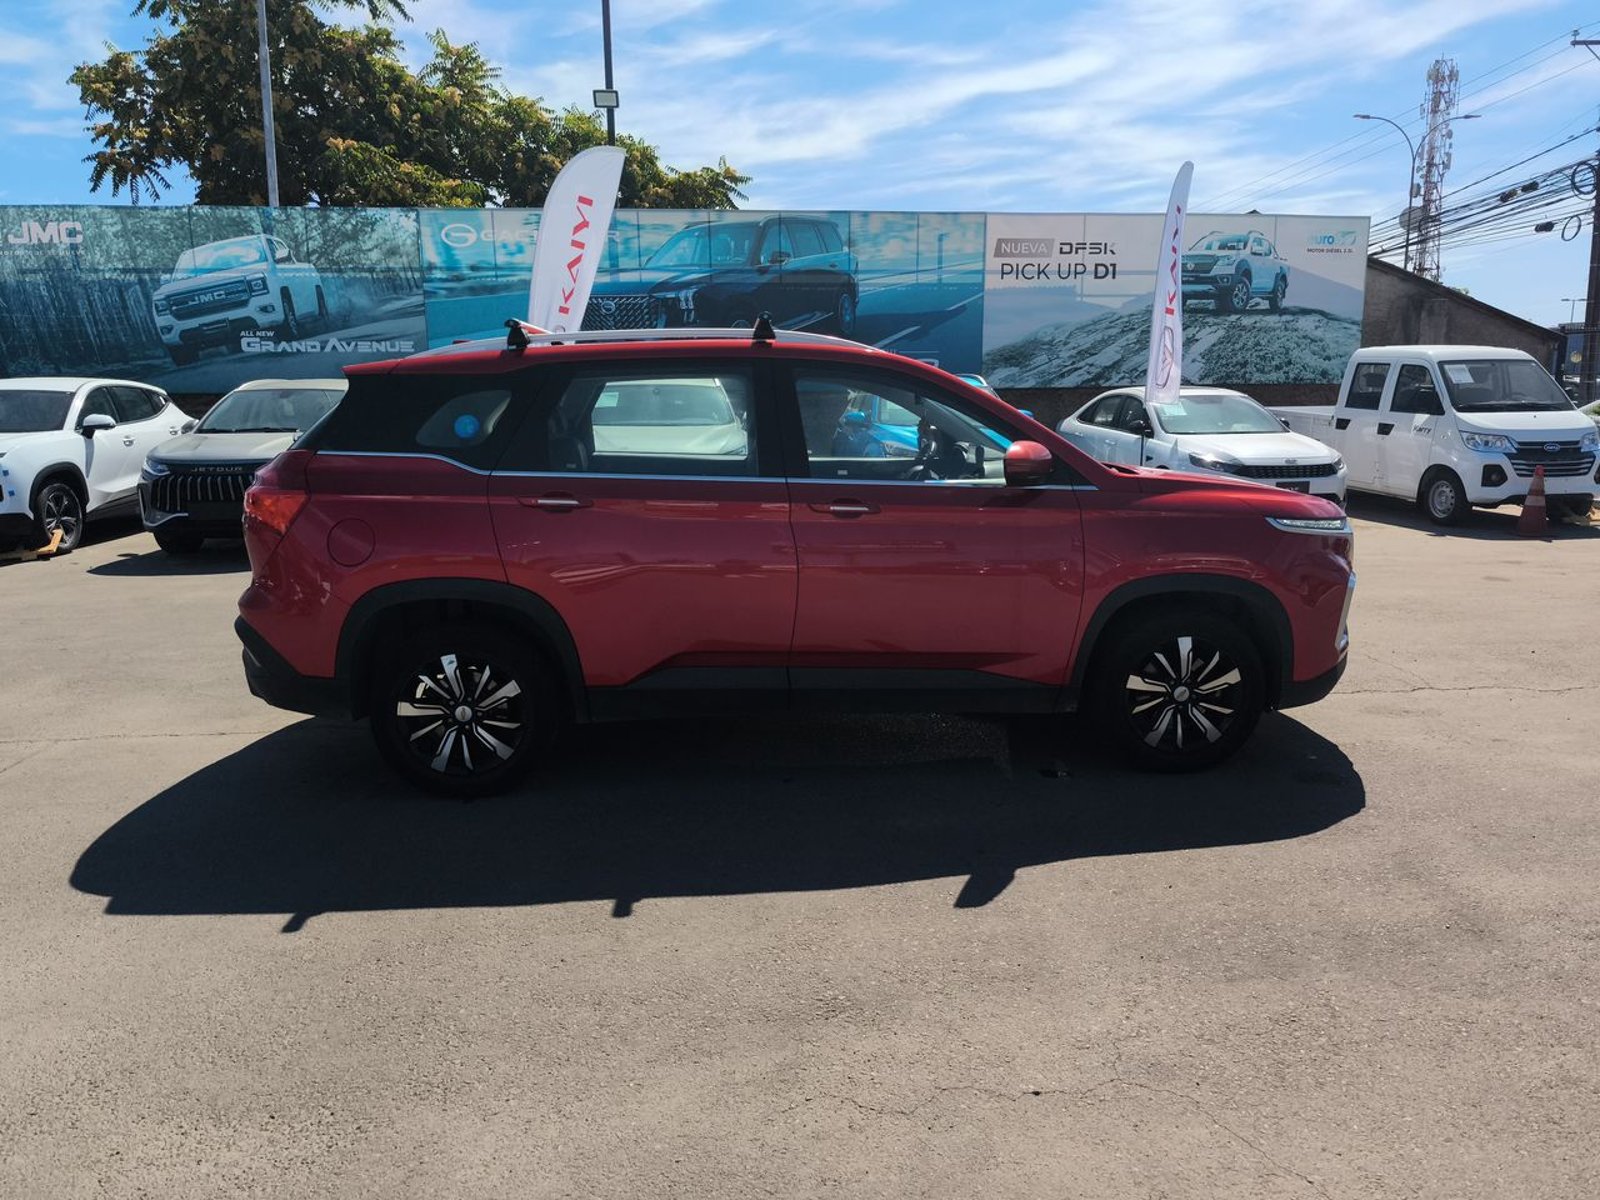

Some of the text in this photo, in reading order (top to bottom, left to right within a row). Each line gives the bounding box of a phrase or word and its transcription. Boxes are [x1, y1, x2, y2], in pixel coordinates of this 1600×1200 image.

[7, 221, 83, 244] JMC
[480, 229, 532, 242] GAC
[558, 195, 593, 315] KAIYI
[1001, 242, 1116, 255] NUEVA DFSK
[1000, 263, 1117, 280] PICK UP D1
[188, 290, 226, 305] JMC
[240, 337, 414, 352] GRAND AVENUE
